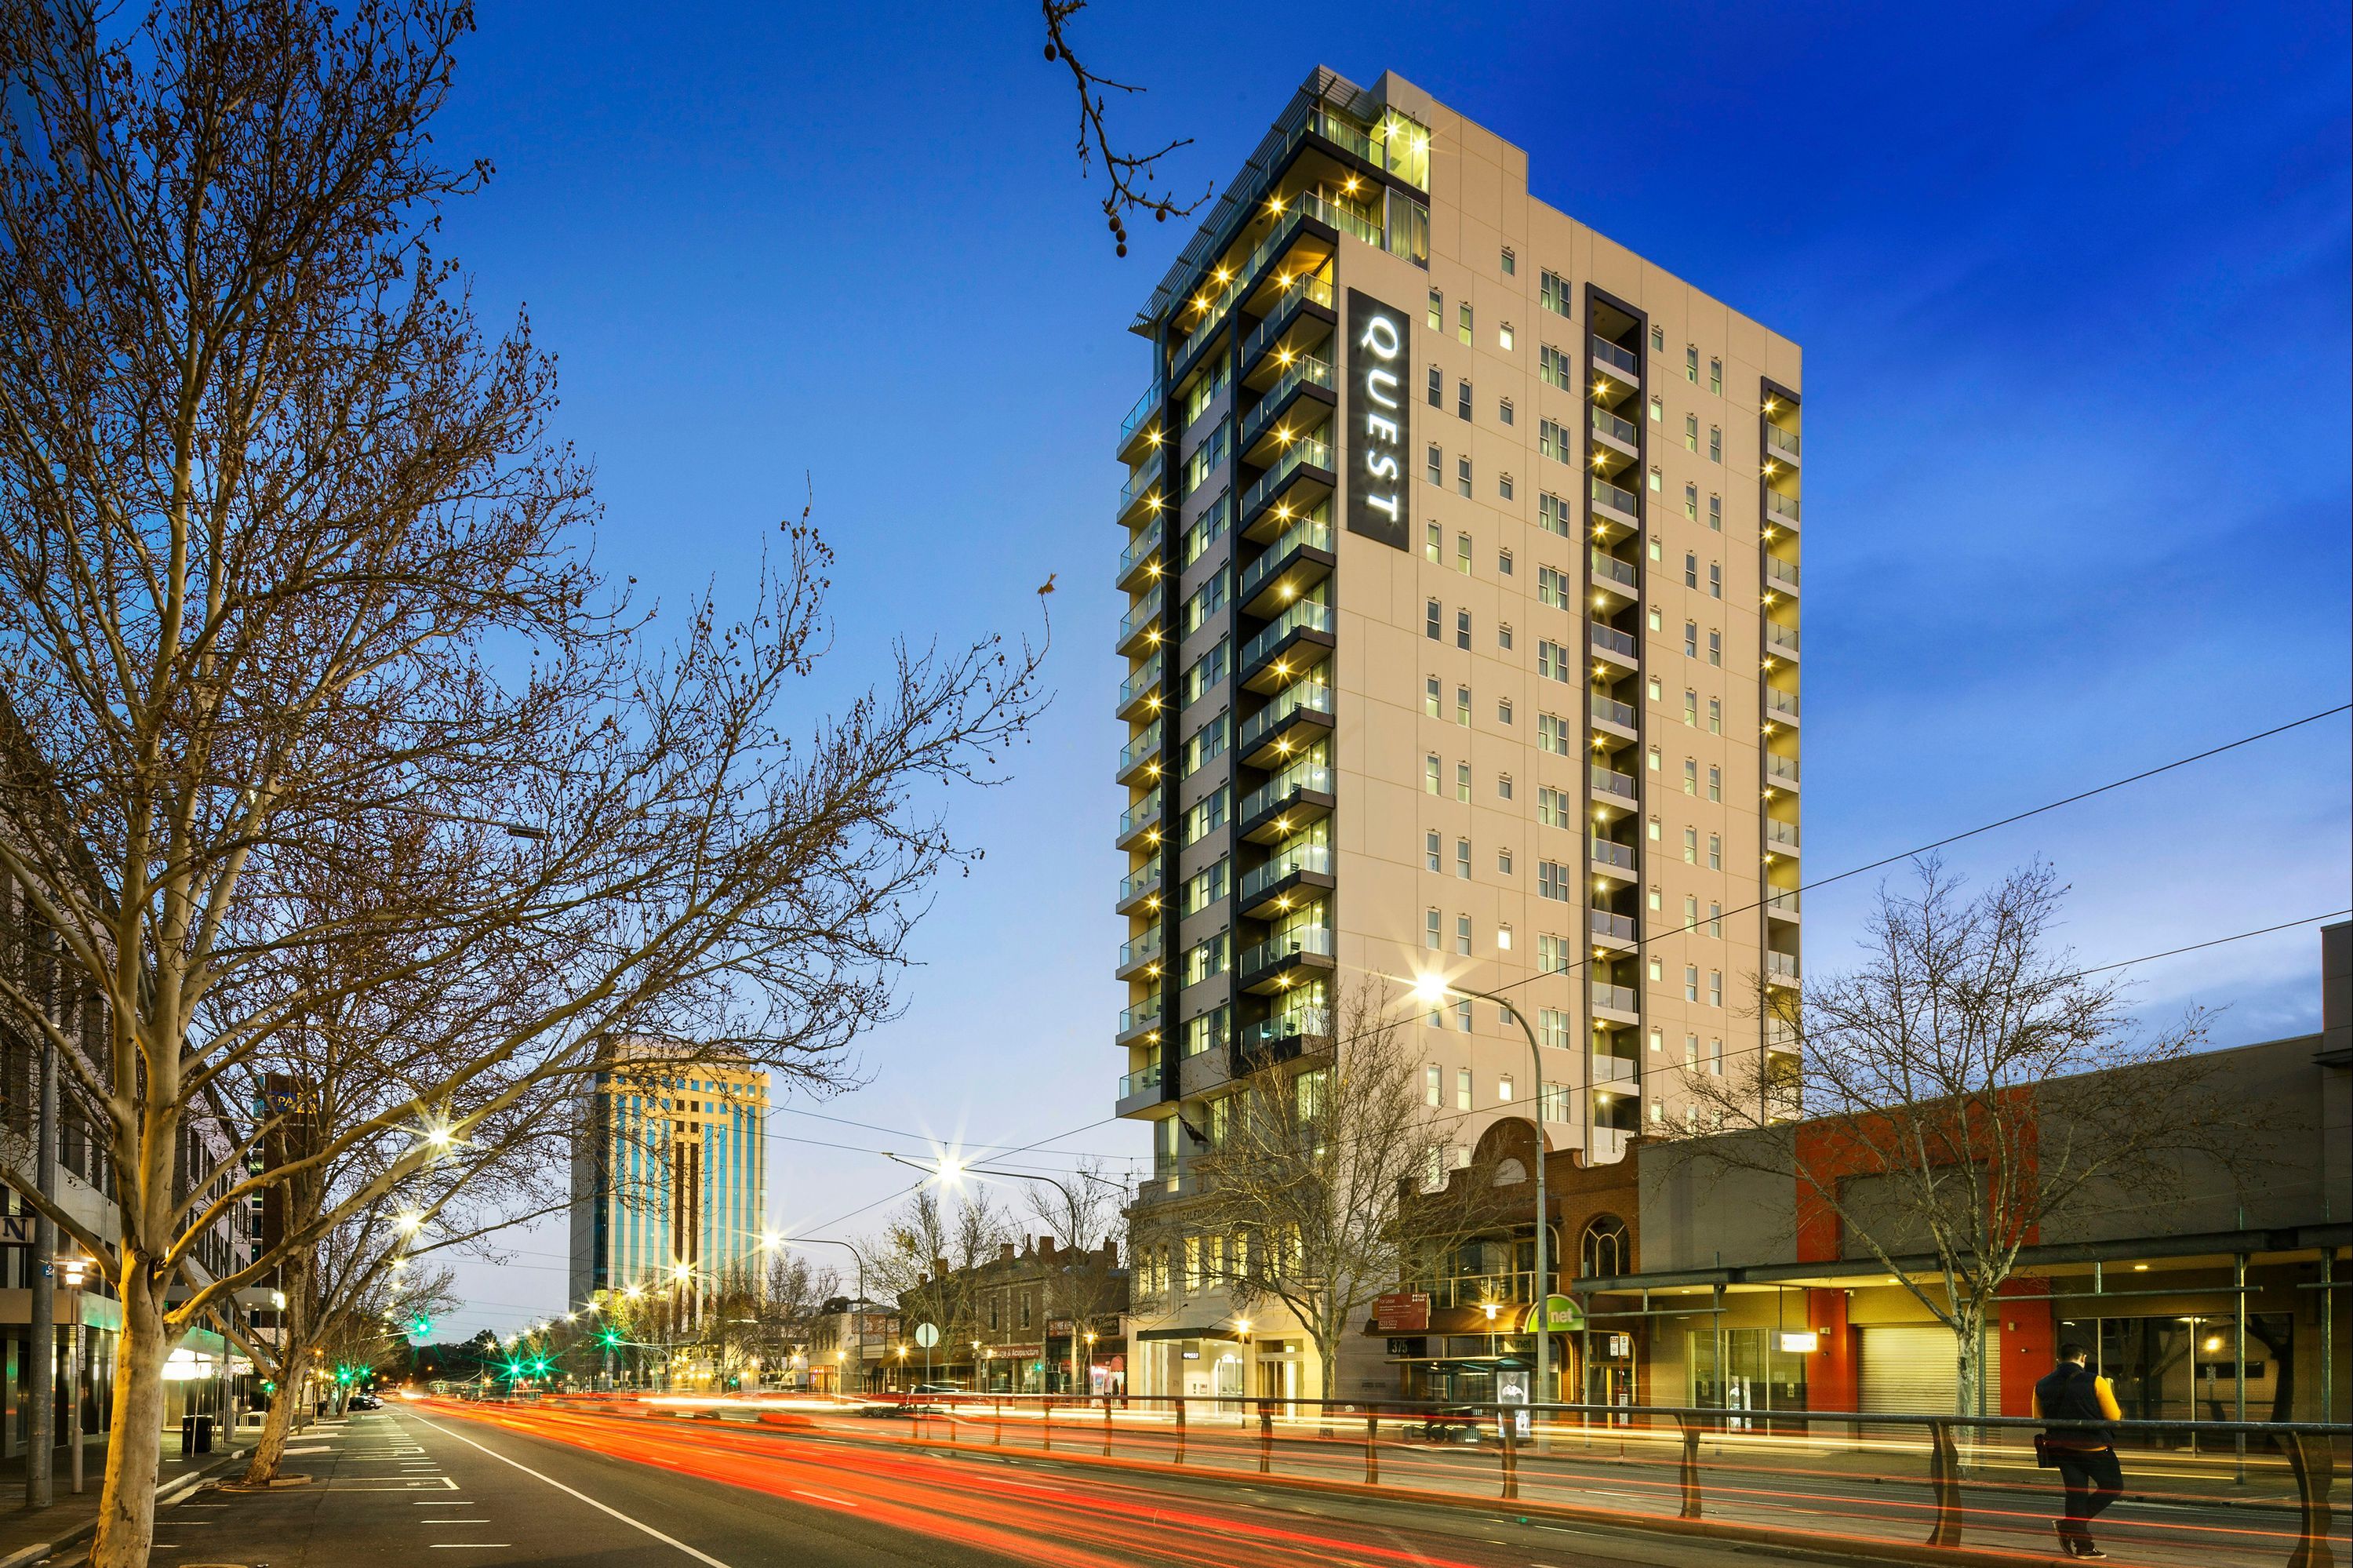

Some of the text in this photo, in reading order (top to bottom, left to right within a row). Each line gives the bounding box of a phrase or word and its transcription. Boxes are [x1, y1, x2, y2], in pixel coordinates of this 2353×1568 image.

[1360, 315, 1399, 522] QUEST
[1551, 1308, 1573, 1323] net
[1012, 1348, 1039, 1358] Acupuncture
[1392, 1339, 1408, 1353] 375
